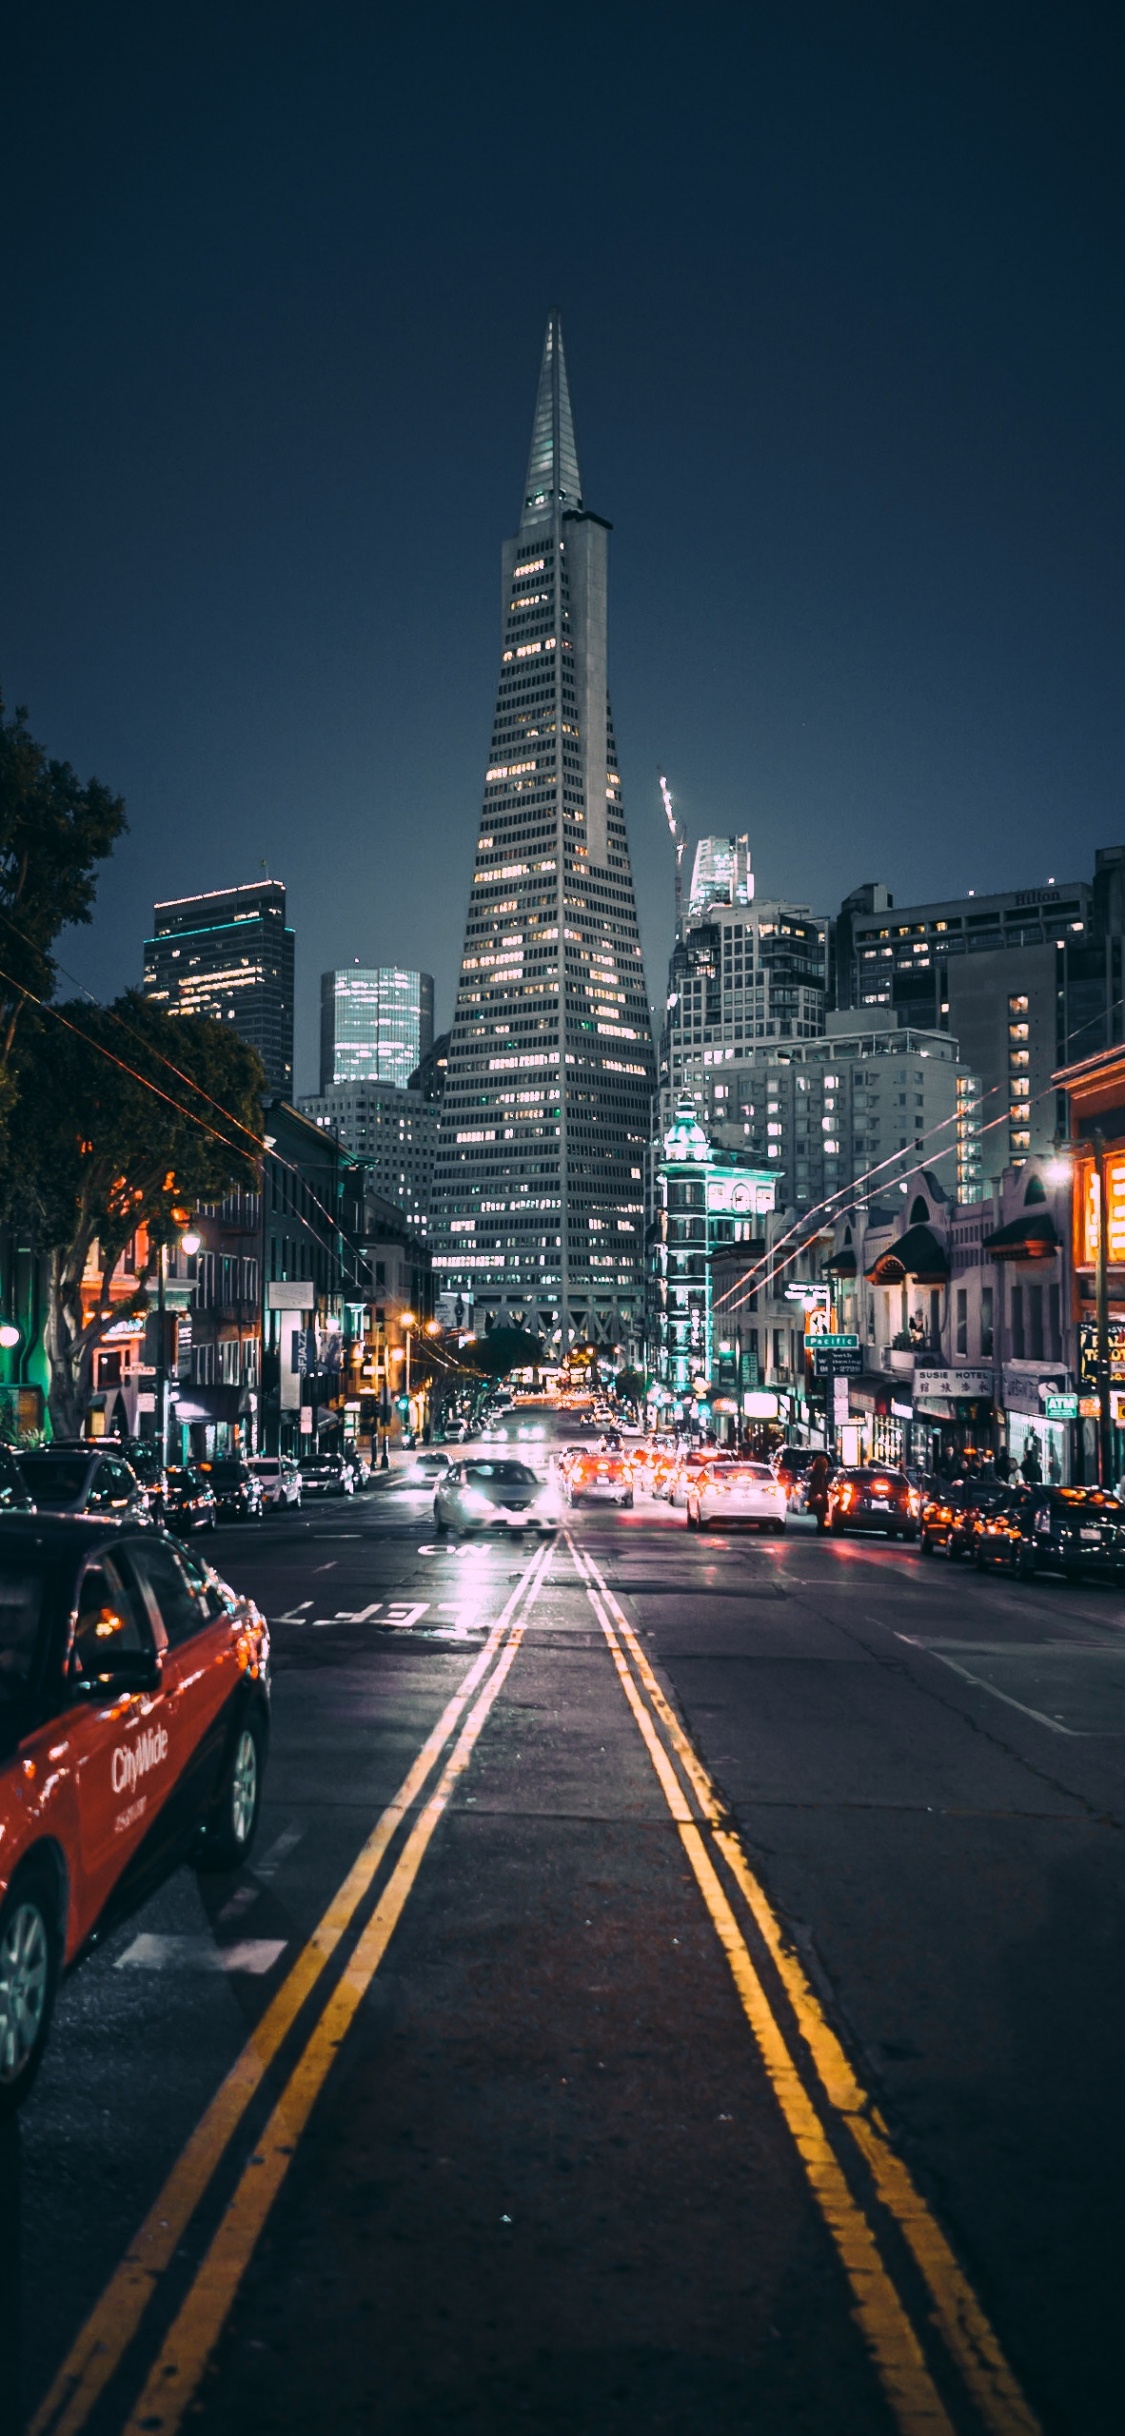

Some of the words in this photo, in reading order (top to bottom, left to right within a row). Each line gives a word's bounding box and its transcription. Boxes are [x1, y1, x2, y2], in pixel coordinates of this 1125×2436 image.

[1015, 891, 1060, 906] Hilton
[810, 1338, 852, 1346] Pacific
[297, 1328, 307, 1375] SFJAZZ
[919, 1371, 948, 1379] SUSIE
[955, 1371, 988, 1379] HOTEL
[1048, 1397, 1074, 1409] ATM
[112, 1722, 168, 1793] CityWide
